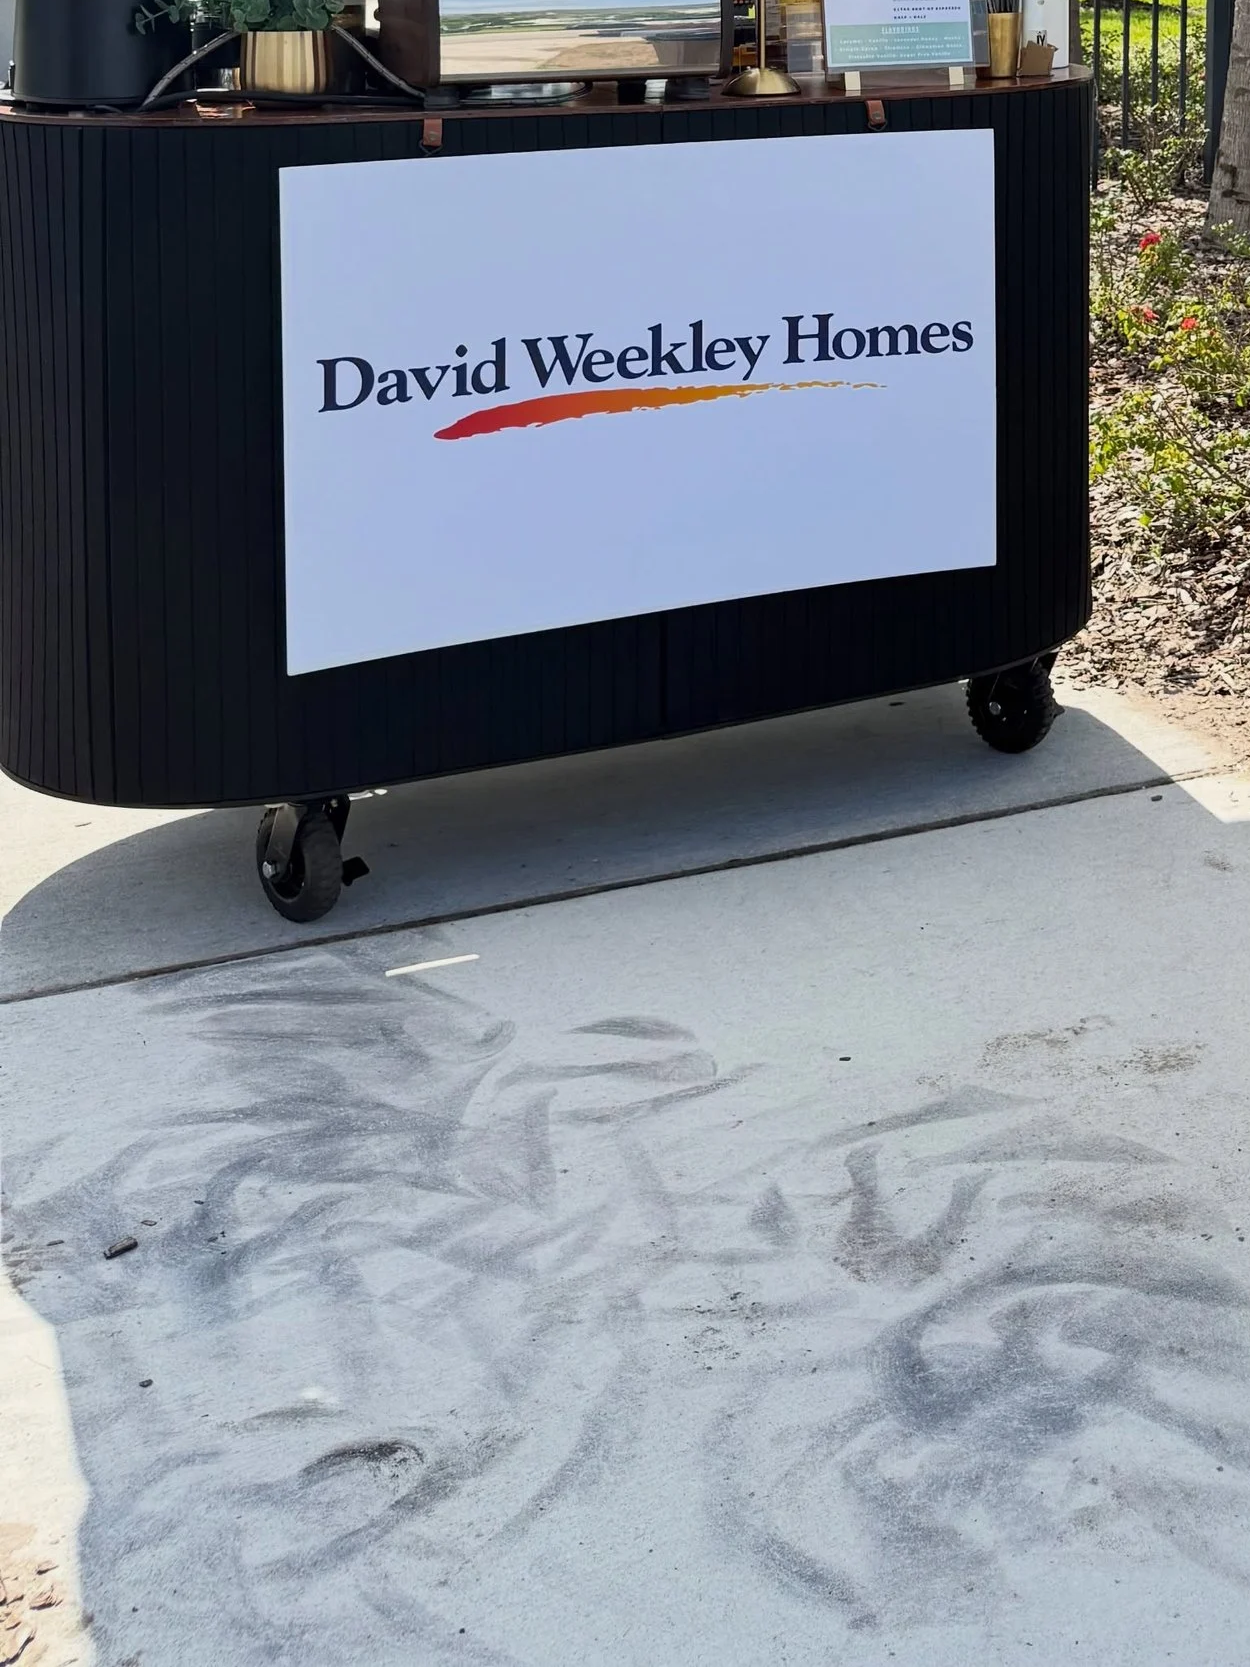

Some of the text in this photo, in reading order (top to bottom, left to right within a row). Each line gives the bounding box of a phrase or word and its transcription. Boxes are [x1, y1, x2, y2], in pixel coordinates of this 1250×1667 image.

[316, 313, 974, 413] David Weekley Homes
